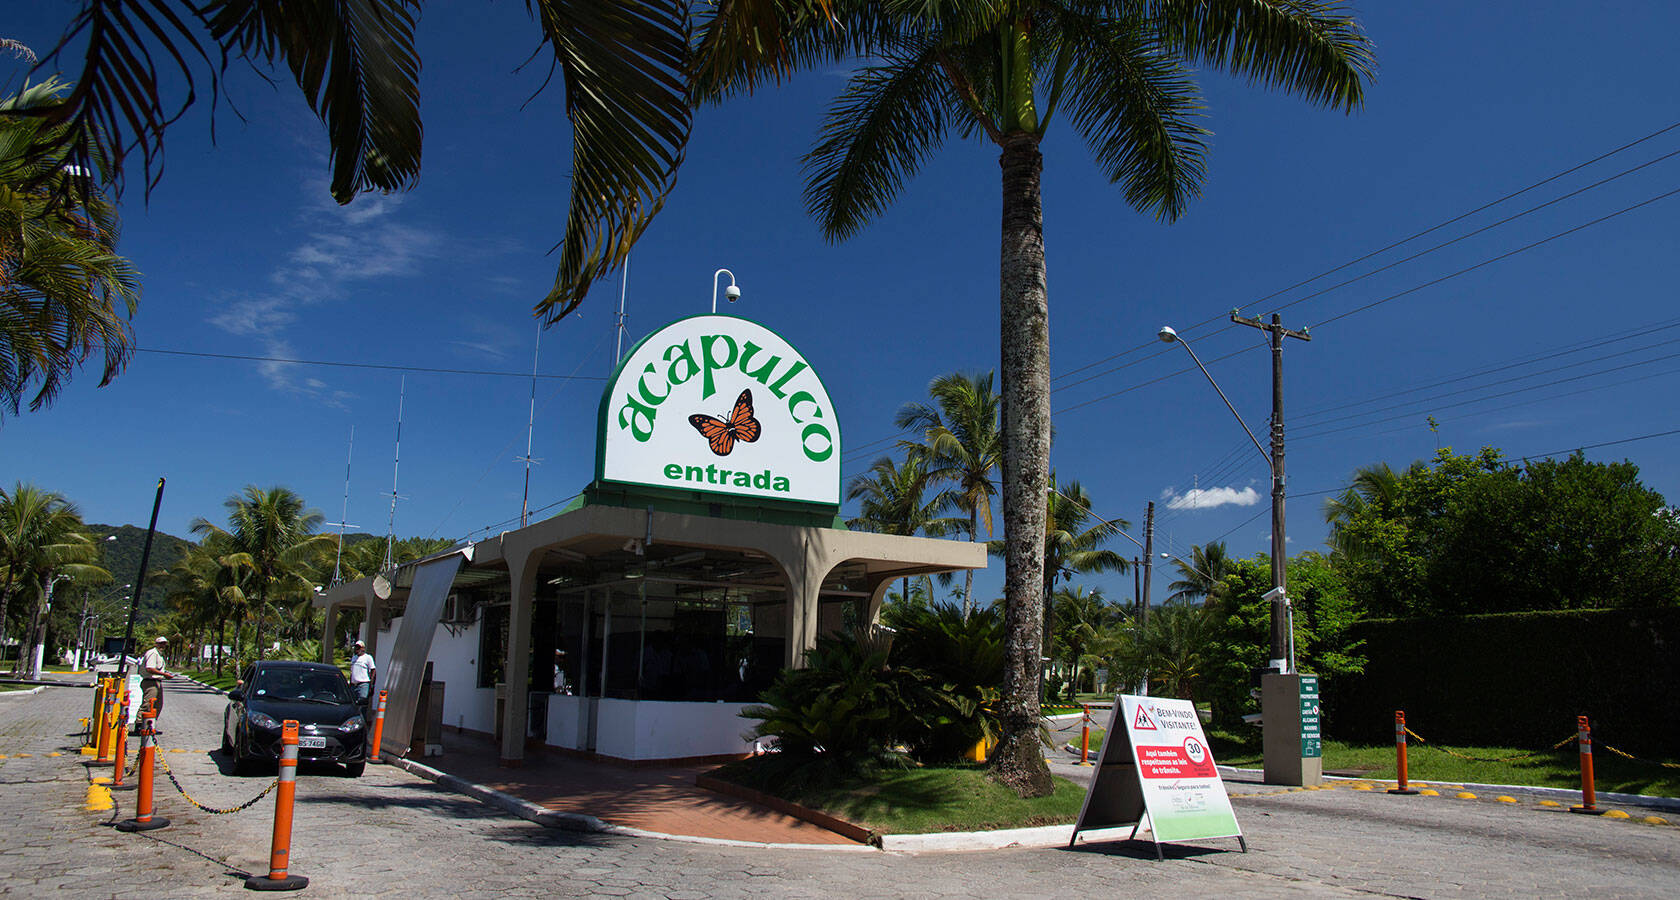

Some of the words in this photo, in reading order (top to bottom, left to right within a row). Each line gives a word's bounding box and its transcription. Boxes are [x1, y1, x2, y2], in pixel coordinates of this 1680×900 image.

[618, 334, 833, 463] acapulco
[663, 463, 790, 492] entrada
[1160, 719, 1197, 730] VISITANTE!
[1187, 743, 1201, 754] 30
